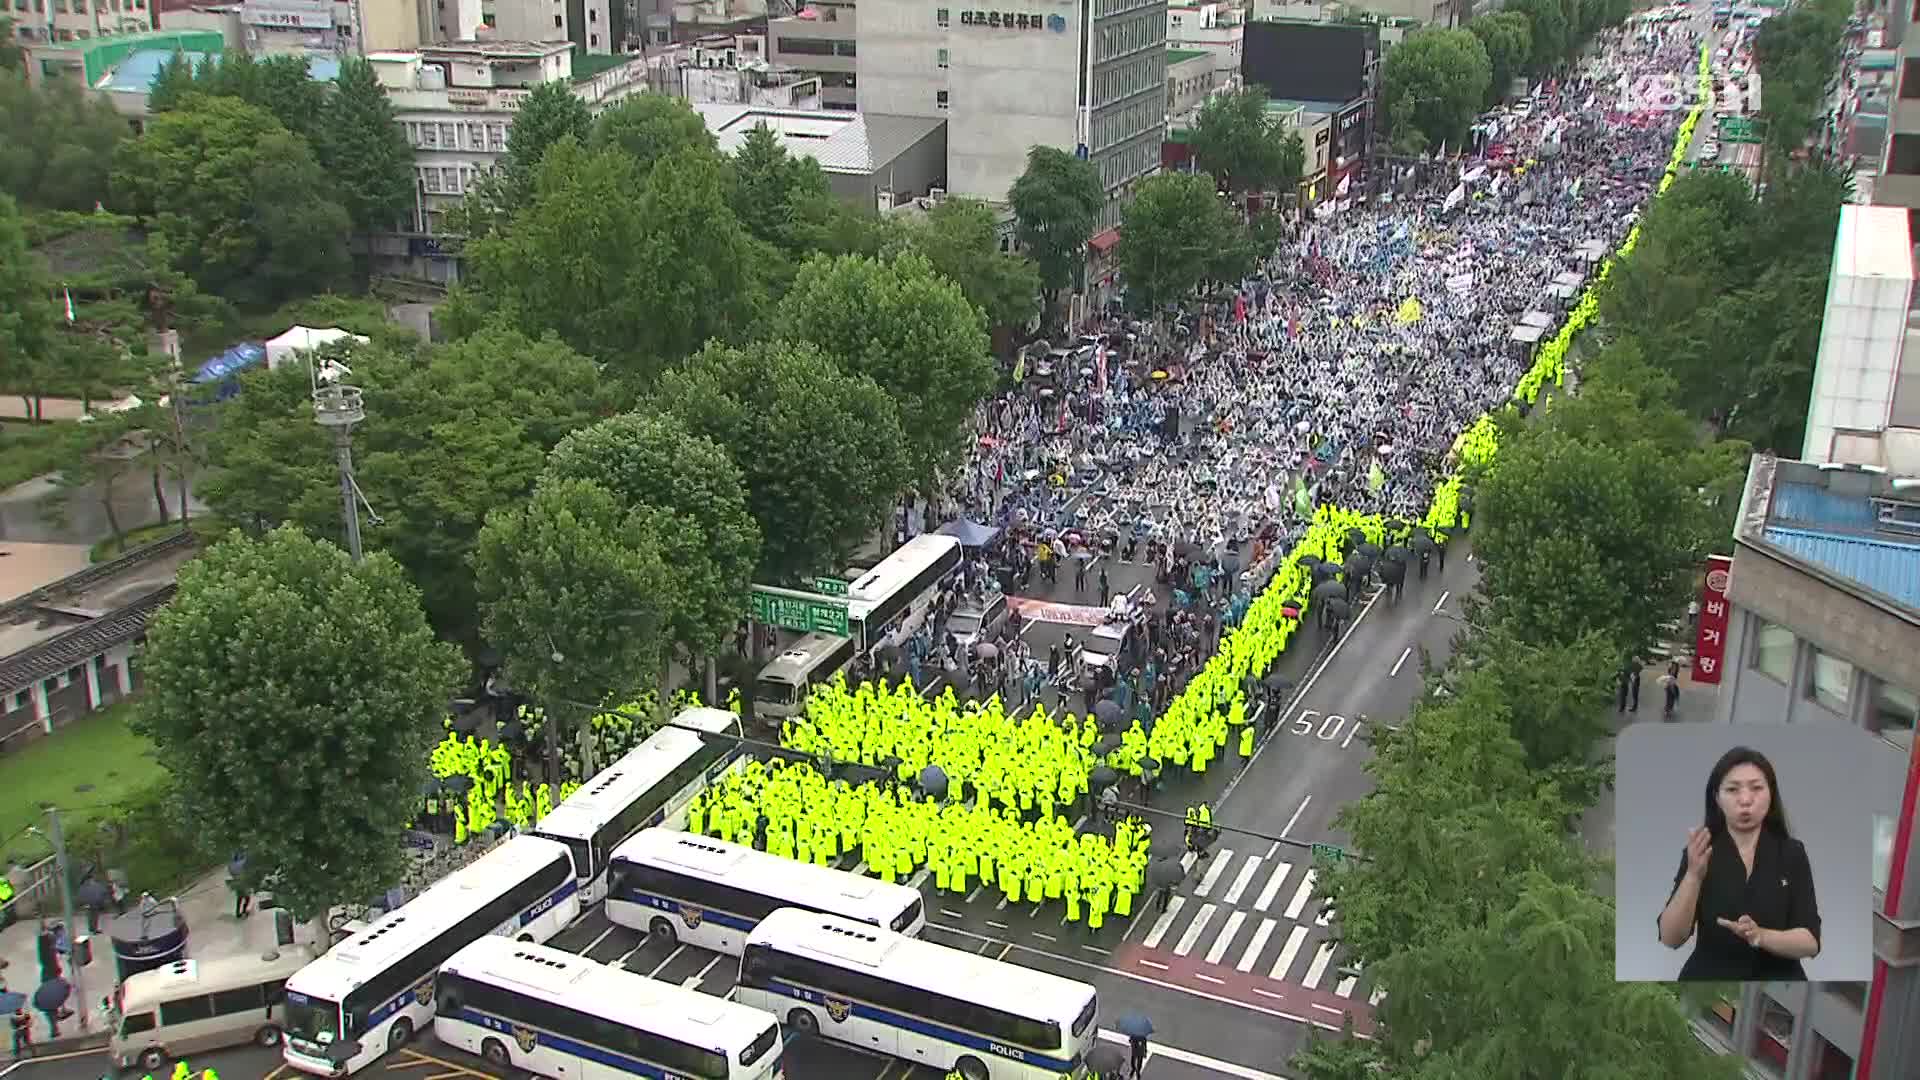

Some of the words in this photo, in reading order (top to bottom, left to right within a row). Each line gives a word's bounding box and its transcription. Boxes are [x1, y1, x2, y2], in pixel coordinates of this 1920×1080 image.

[1700, 600, 1724, 673] 버거킹
[1291, 710, 1345, 740] 50
[530, 897, 553, 917] POLICE
[990, 1043, 1024, 1060] POLICE
